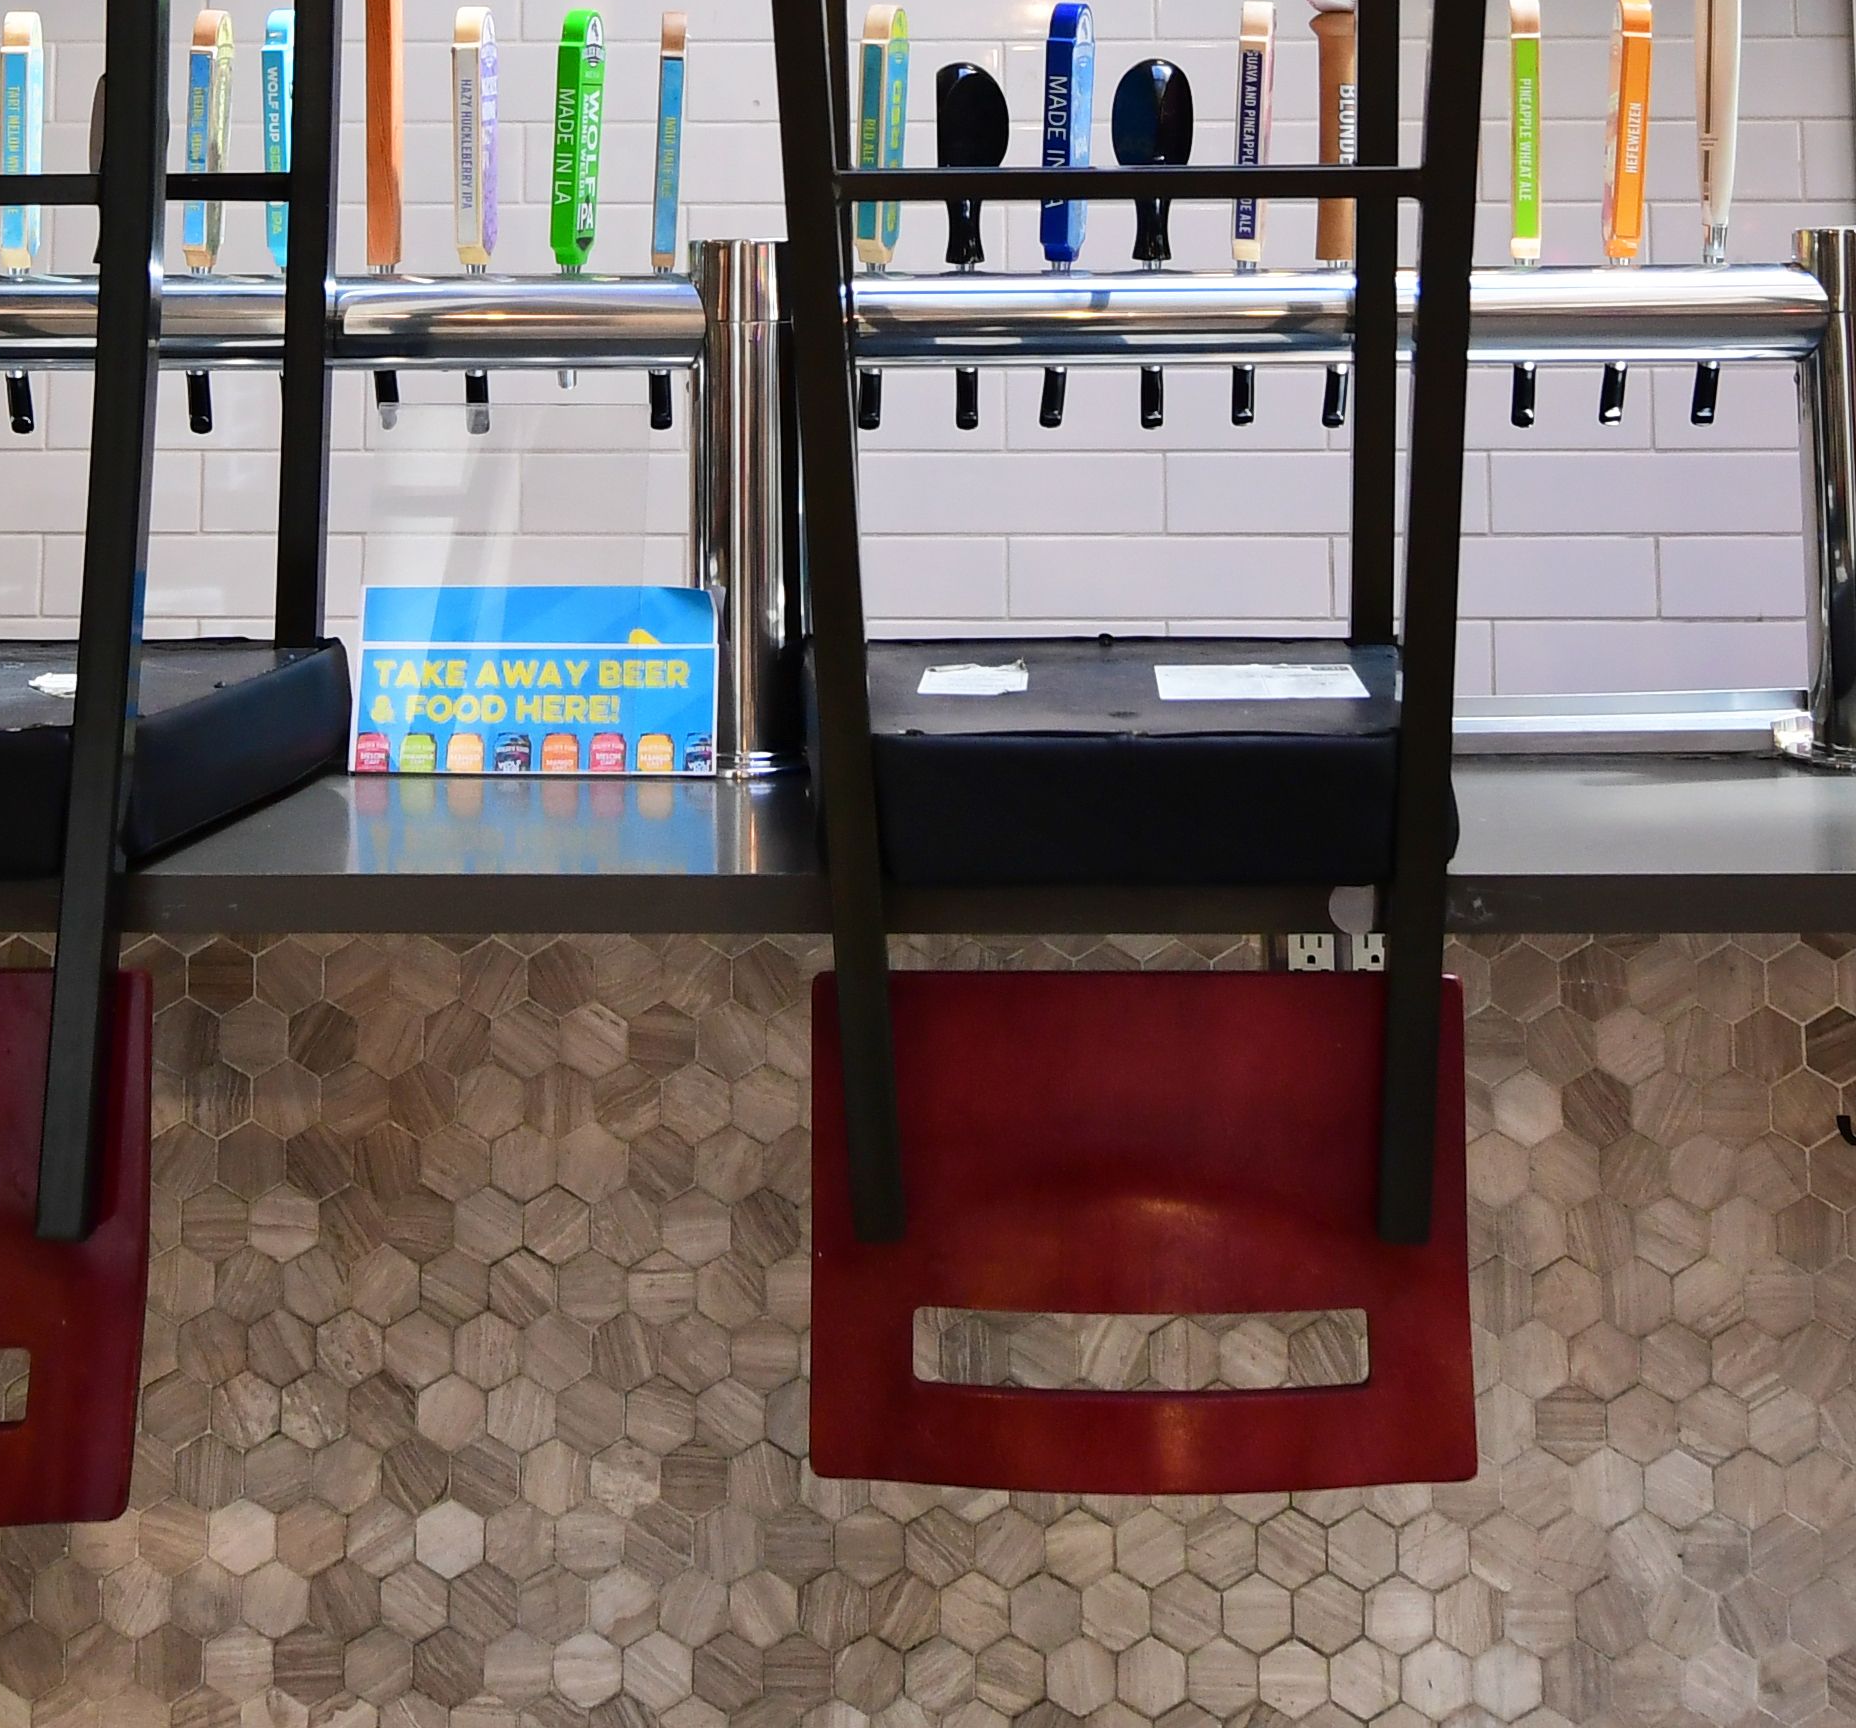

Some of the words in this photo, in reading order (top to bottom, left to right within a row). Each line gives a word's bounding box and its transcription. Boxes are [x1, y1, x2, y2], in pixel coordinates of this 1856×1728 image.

[267, 66, 279, 110] WOLF
[460, 79, 473, 107] HAZY
[1243, 84, 1257, 107] AND
[557, 88, 576, 146] MADE
[1047, 75, 1068, 141] MADE
[1519, 78, 1533, 139] PINEAPPLE
[268, 113, 280, 143] PUP
[584, 89, 601, 197] WOLF
[1625, 102, 1642, 174] HEFEWEIZEN
[460, 111, 473, 188] HUCKLEBERRY
[555, 152, 574, 174] IN
[1519, 141, 1533, 179] WHEAT
[461, 191, 473, 209] IPA
[553, 180, 573, 205] LA
[1519, 182, 1533, 201] ALE
[1238, 214, 1252, 233] ALE
[373, 659, 467, 689] TAKE
[475, 659, 590, 689] AWAY
[598, 659, 692, 689] BEER
[370, 694, 394, 723] &
[405, 694, 508, 723] FOOD
[515, 694, 621, 723] HERE!
